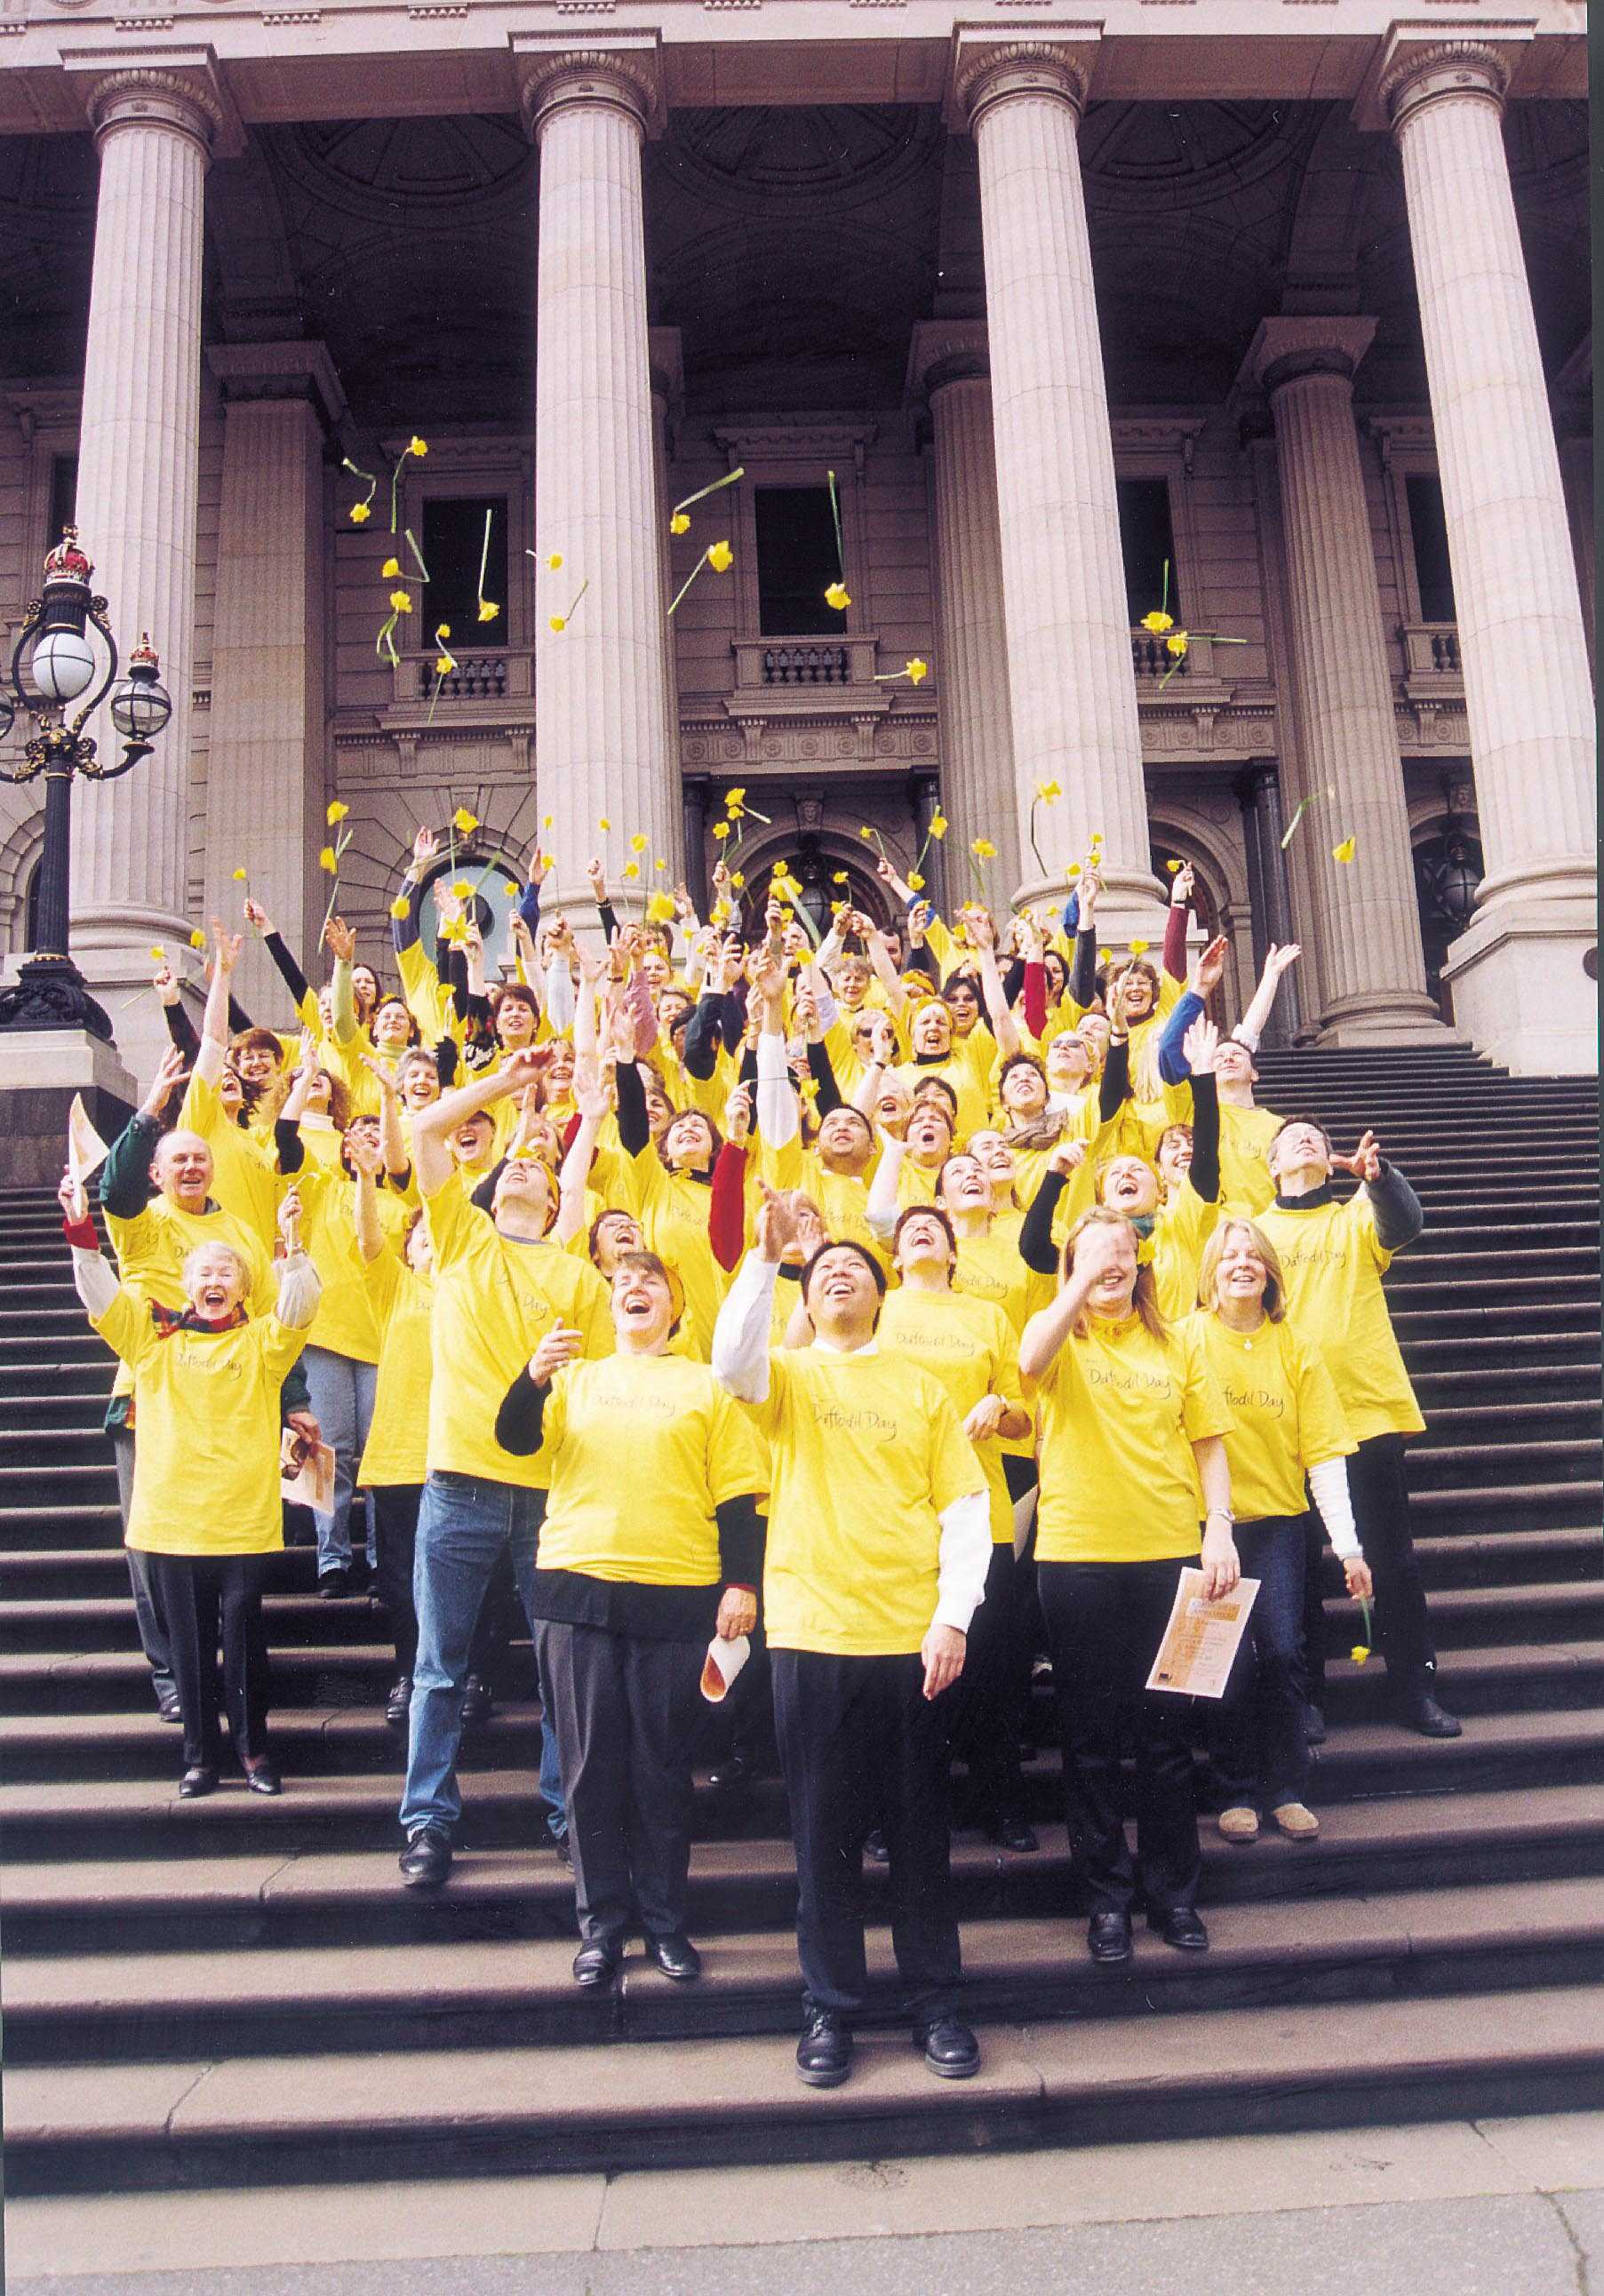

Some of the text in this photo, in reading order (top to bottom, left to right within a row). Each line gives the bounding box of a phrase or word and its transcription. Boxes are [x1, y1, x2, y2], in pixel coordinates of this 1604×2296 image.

[896, 1331, 975, 1358] Daffodil Day
[1143, 1371, 1171, 1401] Day
[1257, 1390, 1285, 1421] Day
[864, 1411, 897, 1443] Day
